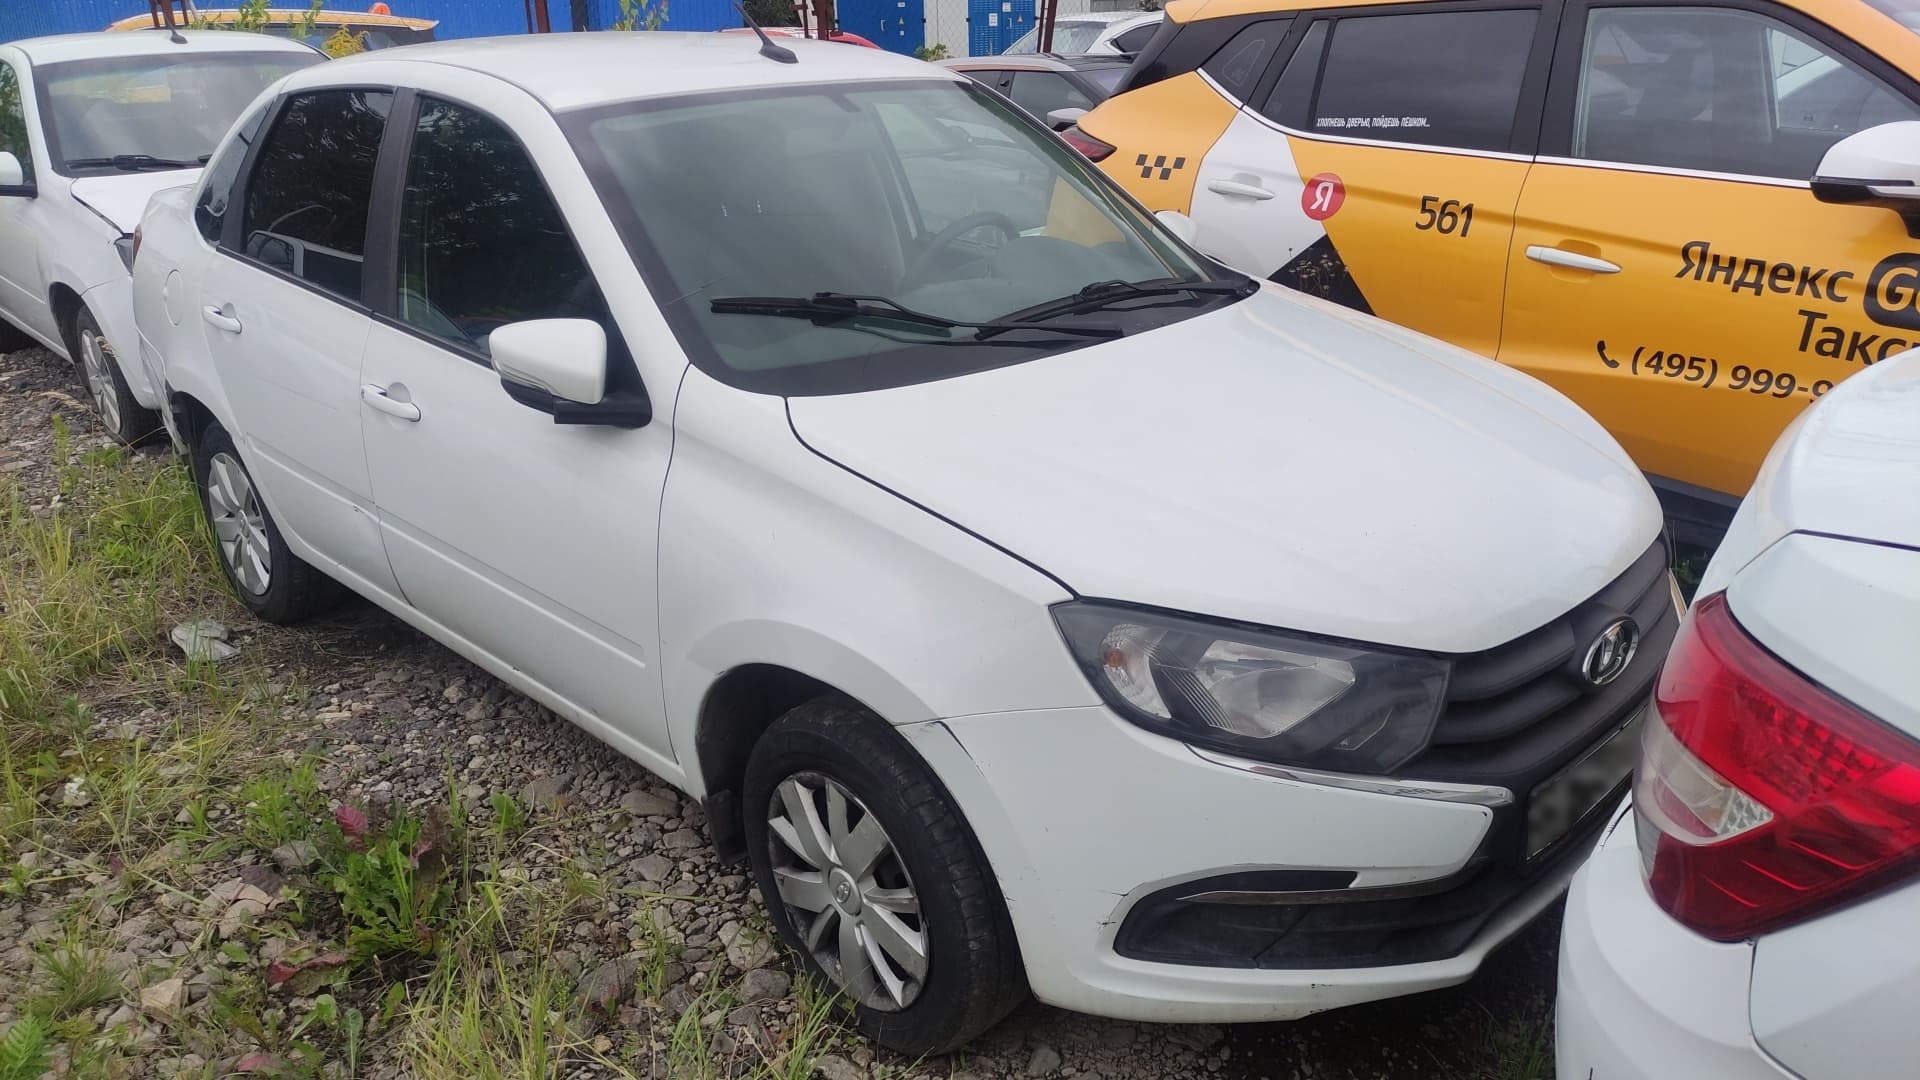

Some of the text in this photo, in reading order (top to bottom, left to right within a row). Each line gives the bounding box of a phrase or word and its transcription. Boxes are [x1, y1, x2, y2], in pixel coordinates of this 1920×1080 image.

[1310, 182, 1334, 212] Я
[1415, 195, 1474, 238] 561
[1675, 240, 1920, 312] Яндекс G
[1798, 309, 1920, 366] Такс
[1631, 346, 1718, 389] (495)
